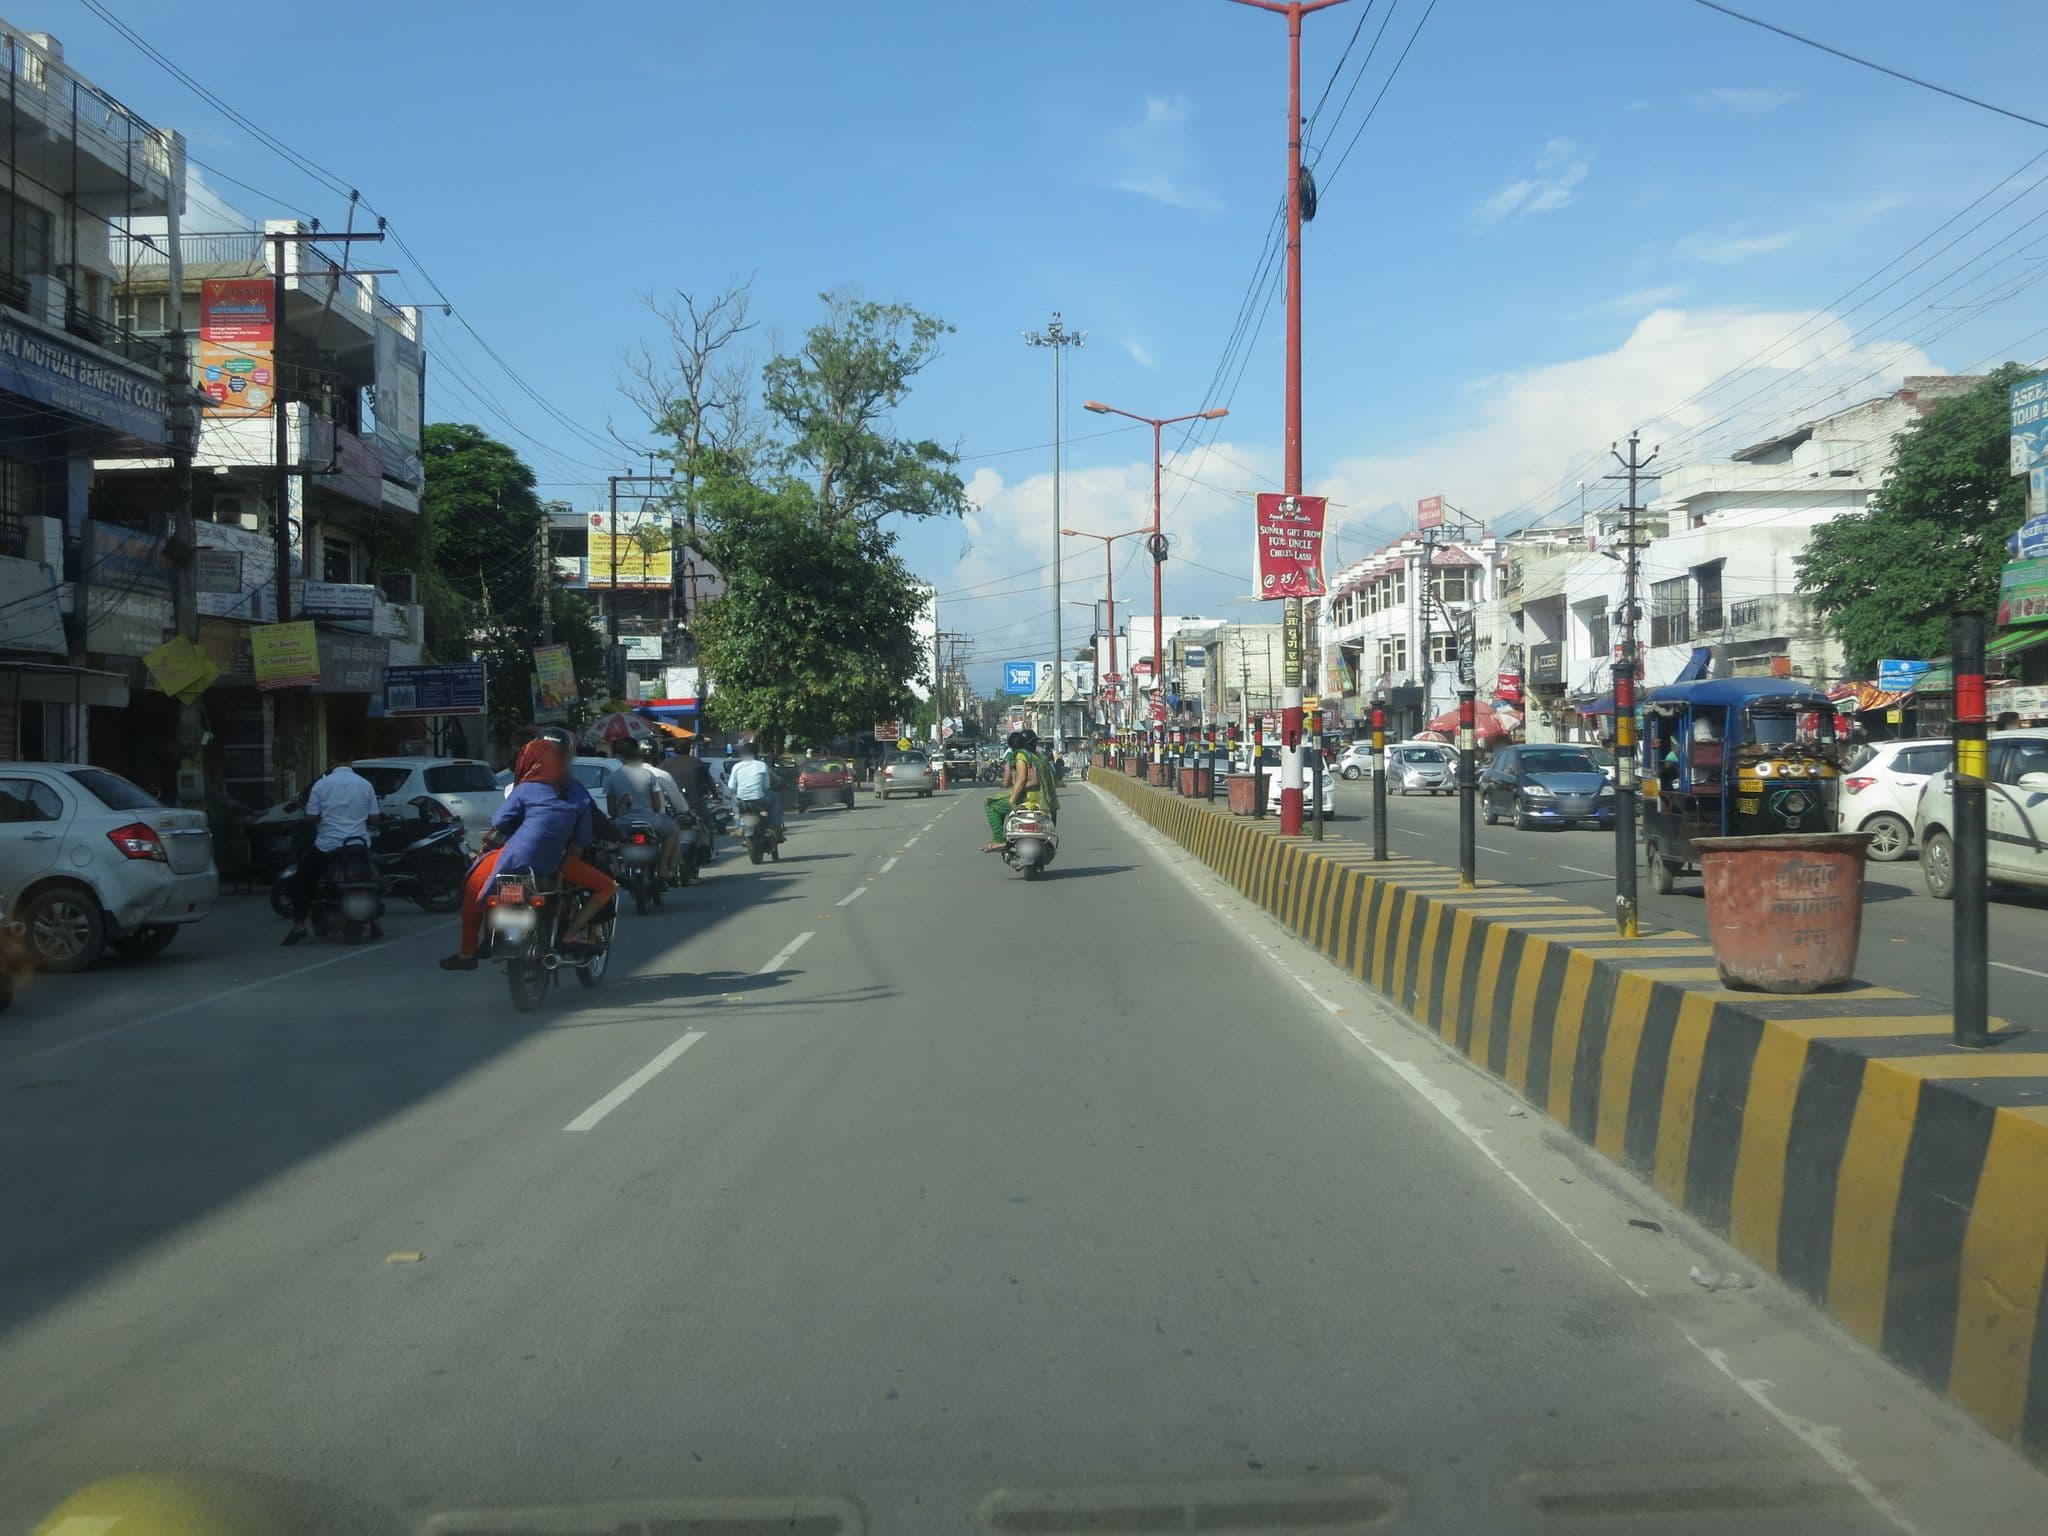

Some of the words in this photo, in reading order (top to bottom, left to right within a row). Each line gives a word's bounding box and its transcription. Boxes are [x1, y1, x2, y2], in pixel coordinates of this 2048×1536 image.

[22, 337, 77, 380] MUTUAL
[79, 359, 132, 402] BENEFITS
[2012, 404, 2040, 427] TOUR
[1287, 528, 1301, 537] GIFT
[1303, 530, 1322, 539] FROM
[1288, 538, 1313, 550] UNCLE
[1294, 550, 1312, 561] LASSI
